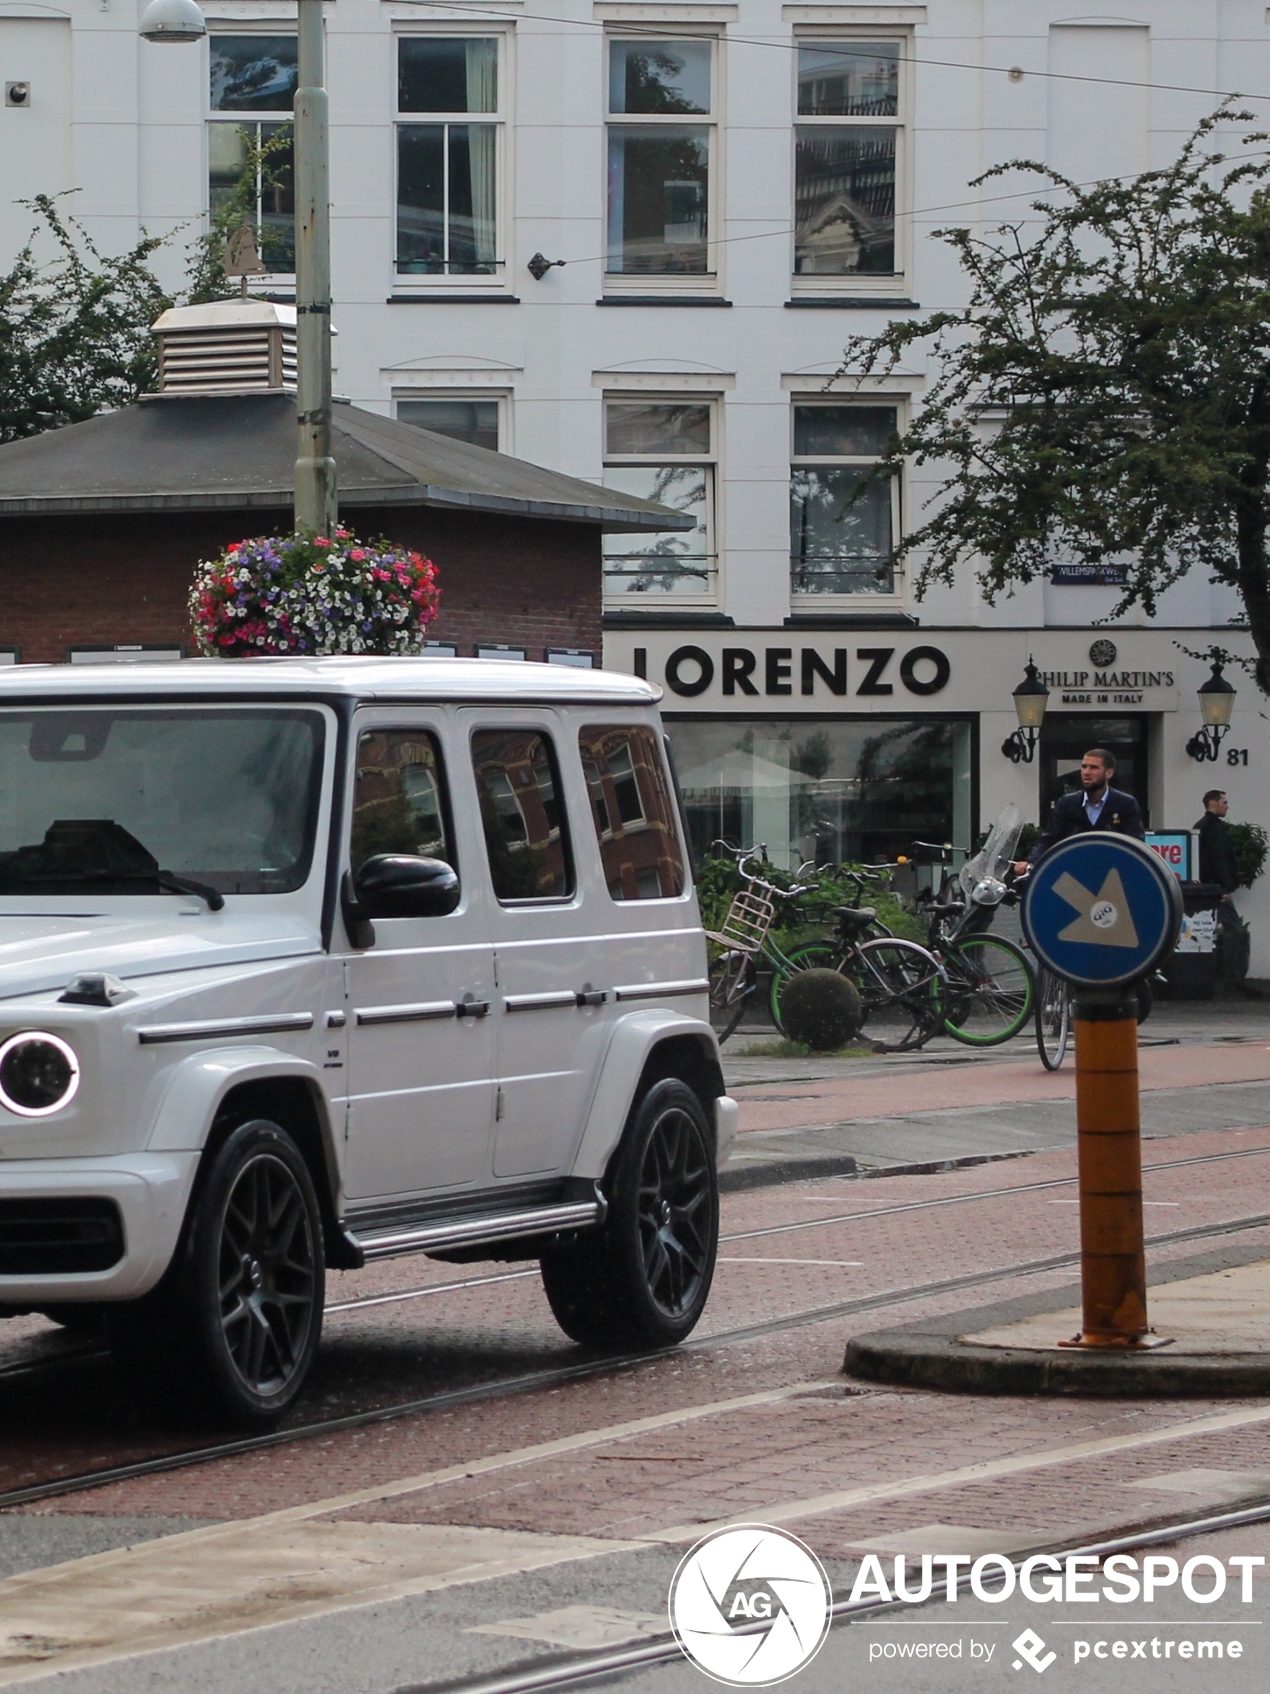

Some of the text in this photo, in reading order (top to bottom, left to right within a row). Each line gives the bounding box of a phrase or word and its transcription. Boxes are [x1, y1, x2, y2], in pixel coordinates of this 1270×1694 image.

[1094, 671, 1174, 688] MARTIN'S
[1062, 694, 1143, 703] MADE IN ITALY
[1227, 748, 1249, 766] 81
